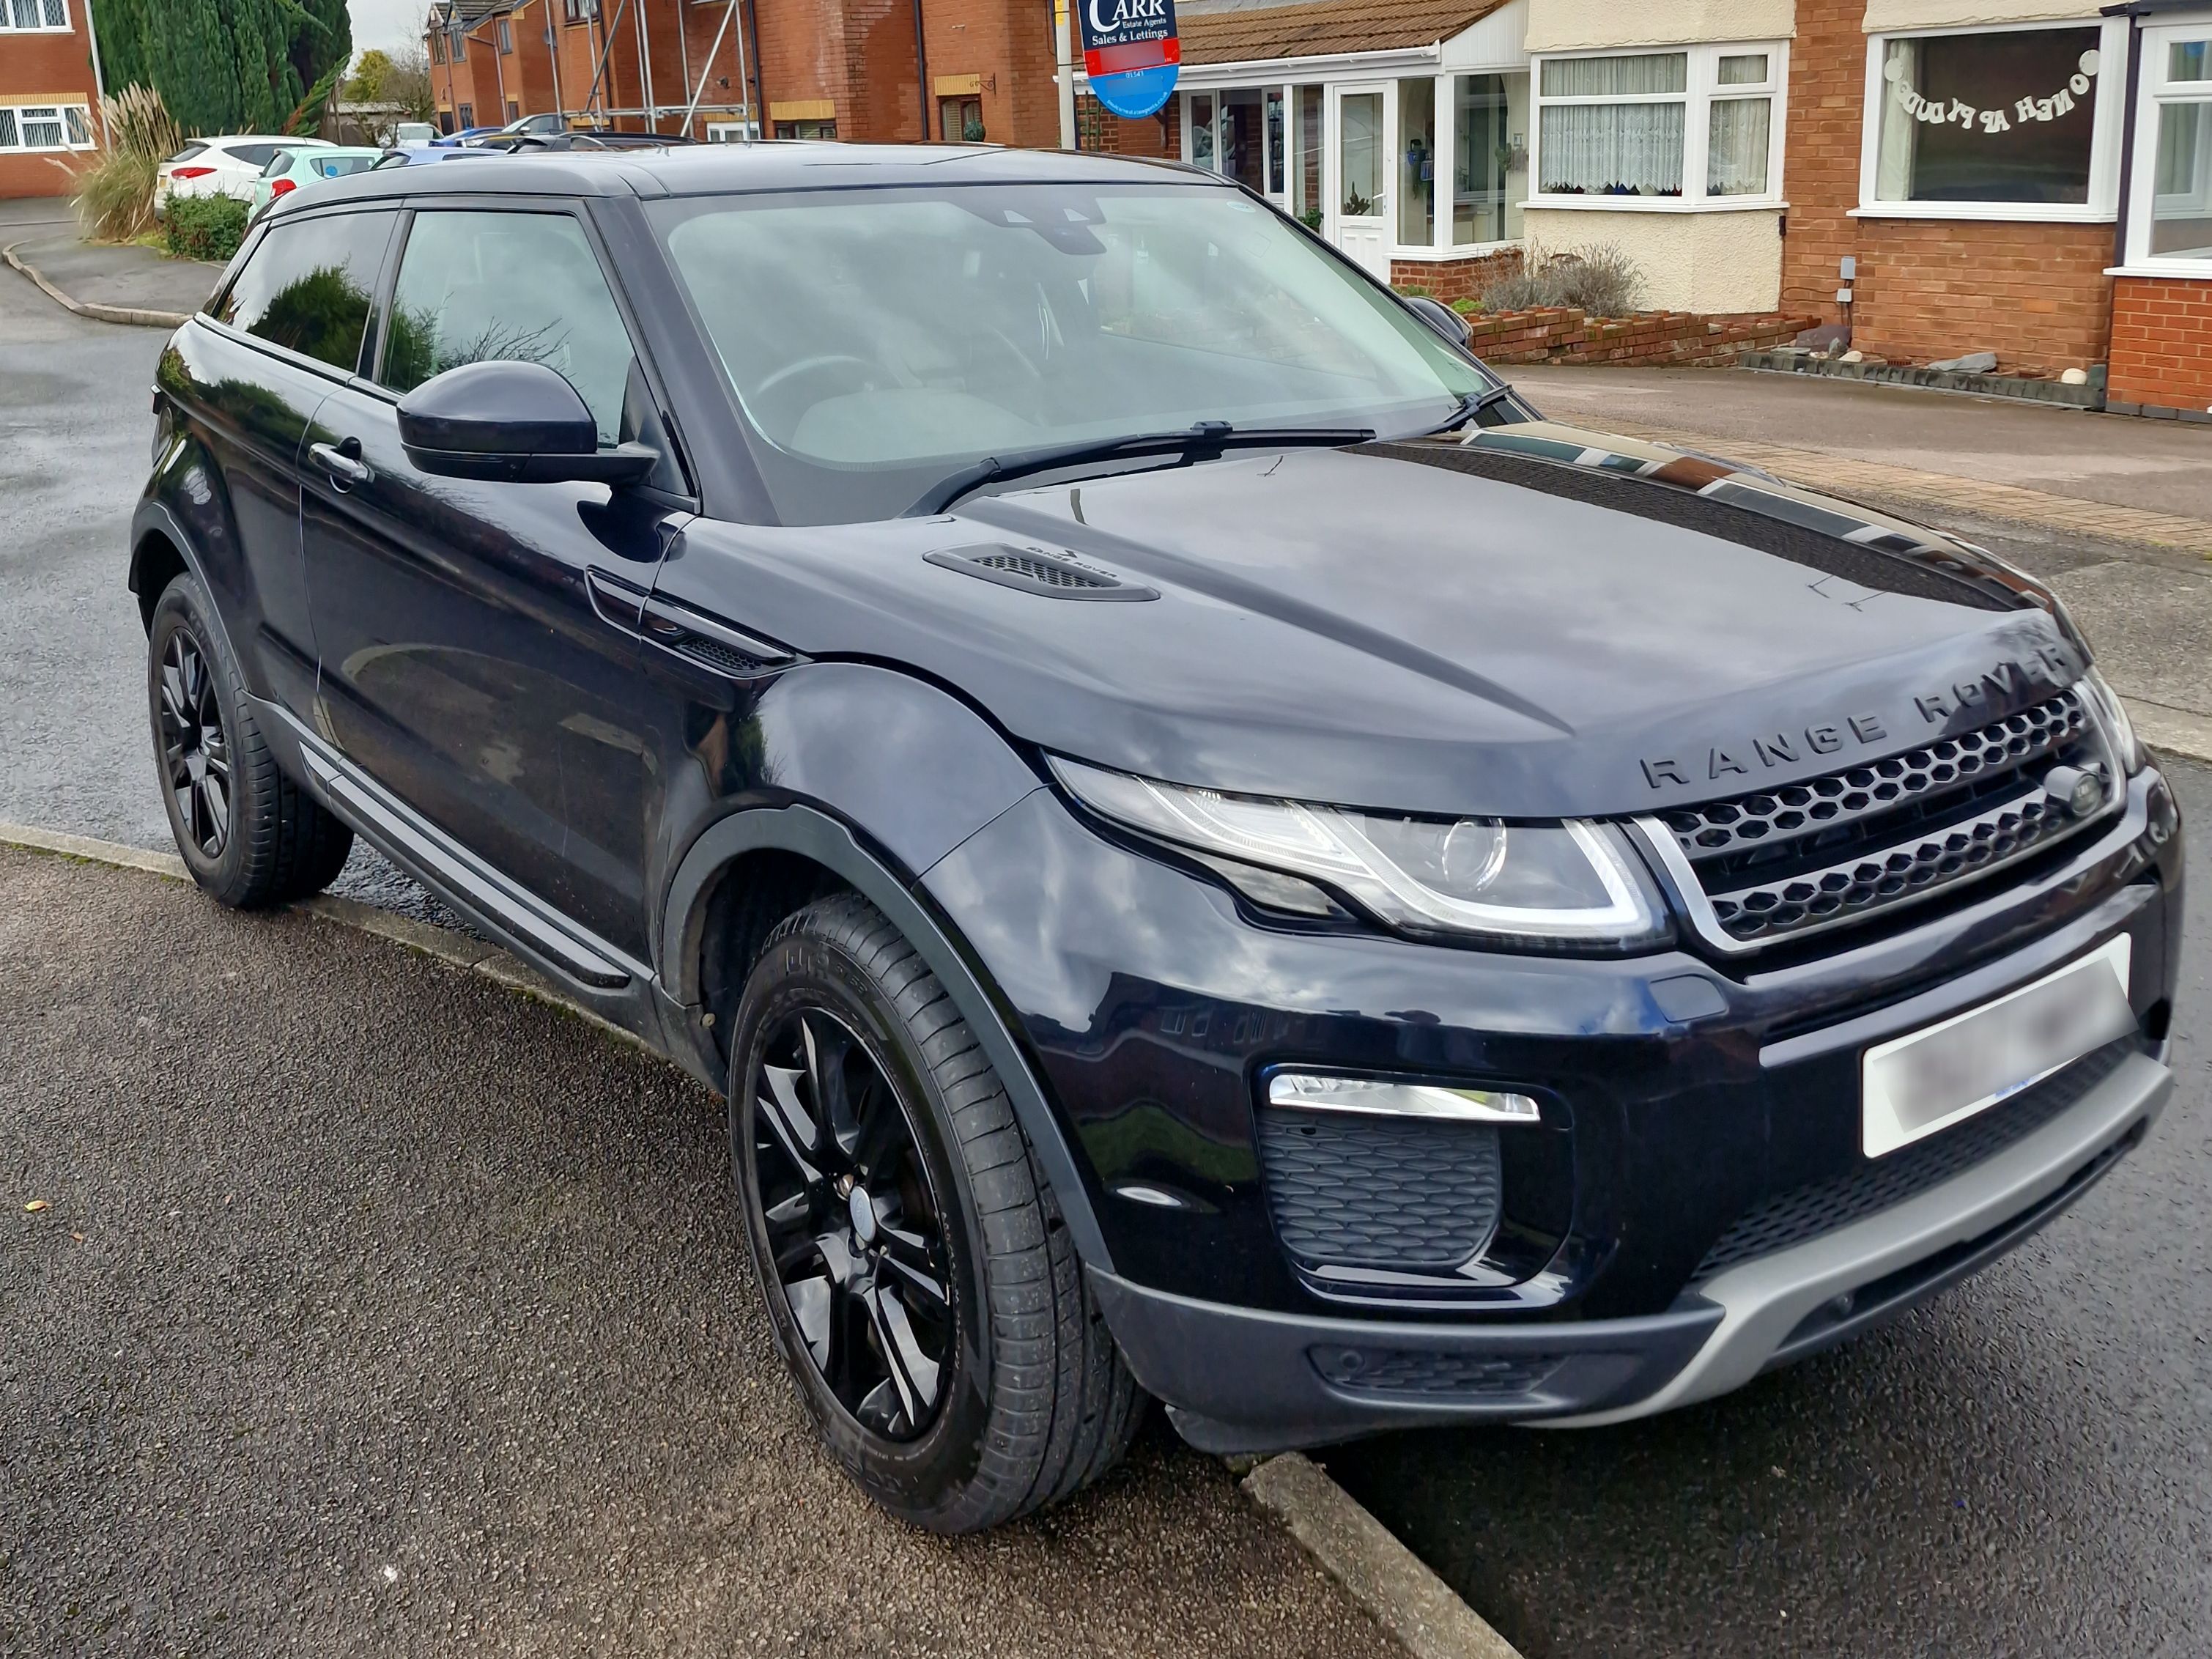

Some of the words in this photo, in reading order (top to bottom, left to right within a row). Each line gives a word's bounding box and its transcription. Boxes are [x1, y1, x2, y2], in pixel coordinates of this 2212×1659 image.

[1089, 0, 1166, 32] CARR
[1122, 21, 1142, 29] Estate
[1144, 18, 1166, 27] Agents
[1092, 34, 1117, 45] Sales
[1119, 32, 1127, 42] &
[1130, 29, 1168, 40] Lettings
[1640, 713, 1887, 789] RANGE
[1913, 643, 2074, 723] ROVER
